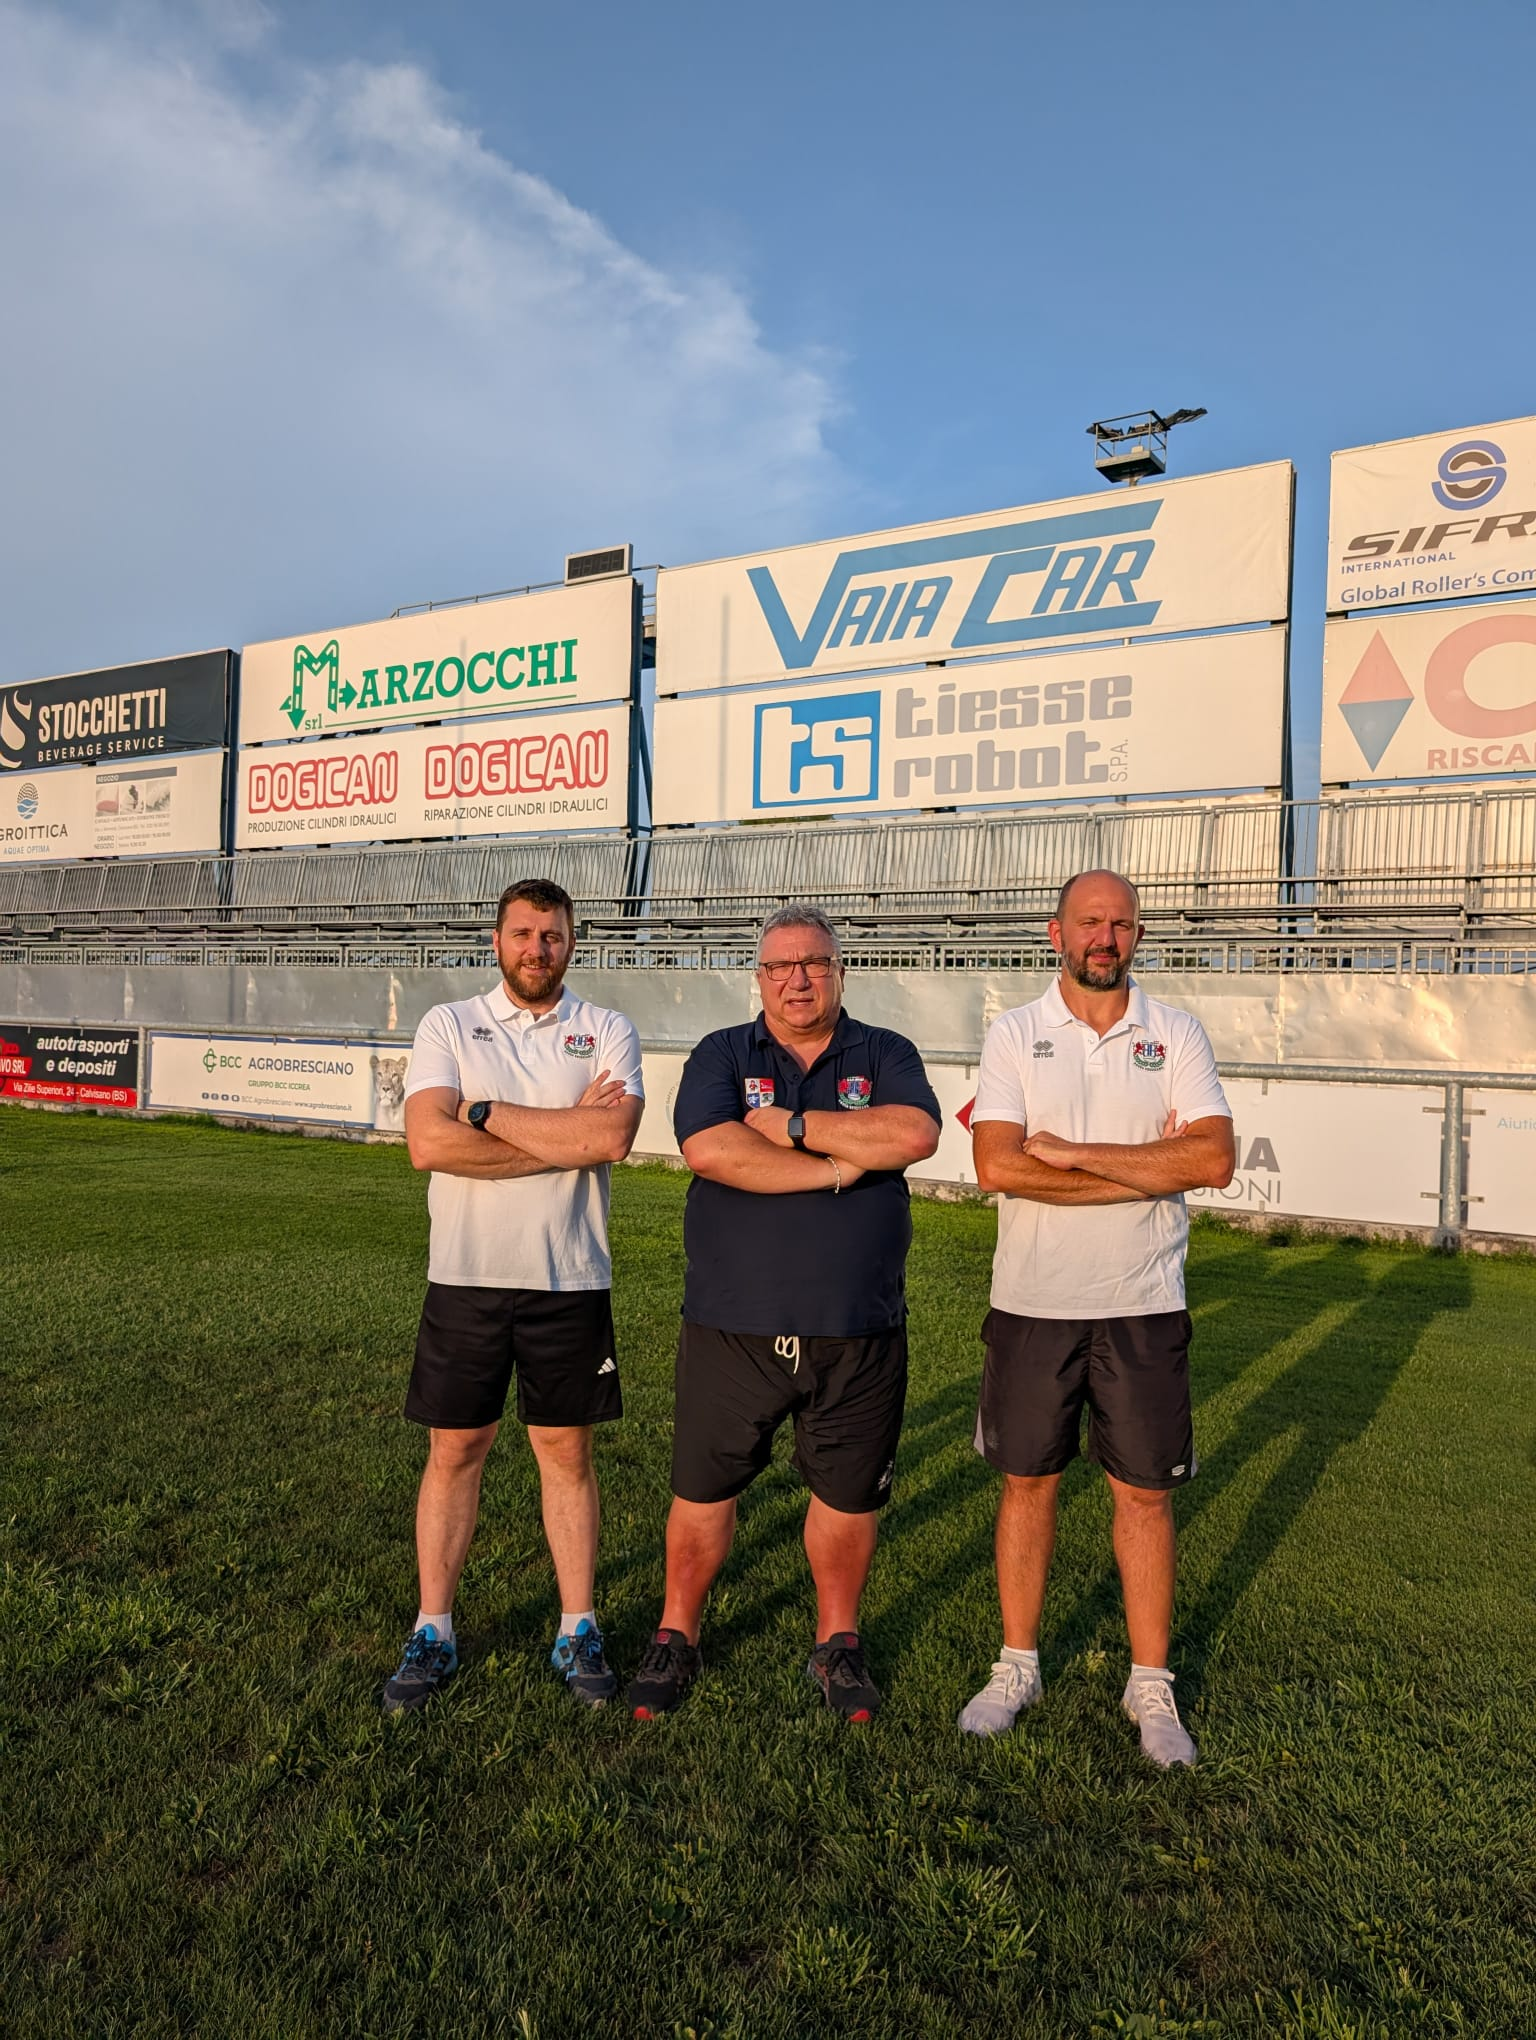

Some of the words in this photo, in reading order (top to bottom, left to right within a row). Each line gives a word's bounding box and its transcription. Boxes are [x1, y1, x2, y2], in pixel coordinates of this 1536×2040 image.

[1342, 511, 1536, 561] SIFR
[1341, 552, 1456, 574] INTERNATIONAL
[746, 548, 953, 670] VAIA
[951, 538, 1164, 649] CAR
[1341, 581, 1405, 604] Global
[290, 639, 579, 730] MARZOCCHI
[38, 687, 167, 743] STOCCHETTI
[895, 675, 1132, 739] tiesse
[304, 714, 323, 730] srl
[38, 743, 102, 763] BEVERAGE
[107, 735, 165, 754] SERVICE
[1110, 738, 1129, 783] S.P.A.
[1427, 742, 1536, 770] RISCA
[425, 729, 608, 800] DOGICAN
[894, 730, 1108, 798] robot
[249, 751, 398, 813] DOGICAN
[248, 817, 305, 833] PRODUZIONE
[308, 815, 347, 830] CILINDRI
[350, 812, 397, 827] IDRAULICI
[424, 805, 493, 821] RIPARAZIONE
[496, 801, 546, 817] CILINDRI
[549, 798, 608, 813] IDRAULICI
[36, 1036, 129, 1057] autotrasporti
[46, 1059, 54, 1072] e
[58, 1057, 117, 1077] depositi
[219, 1055, 242, 1069] BCC
[248, 1056, 354, 1076] AGROBRESCIANO
[13, 1082, 23, 1092] Via
[80, 1087, 111, 1100] Calvisano
[112, 1090, 127, 1103] (BS)
[248, 1080, 274, 1089] GRUPPO
[274, 1081, 288, 1090] BCC
